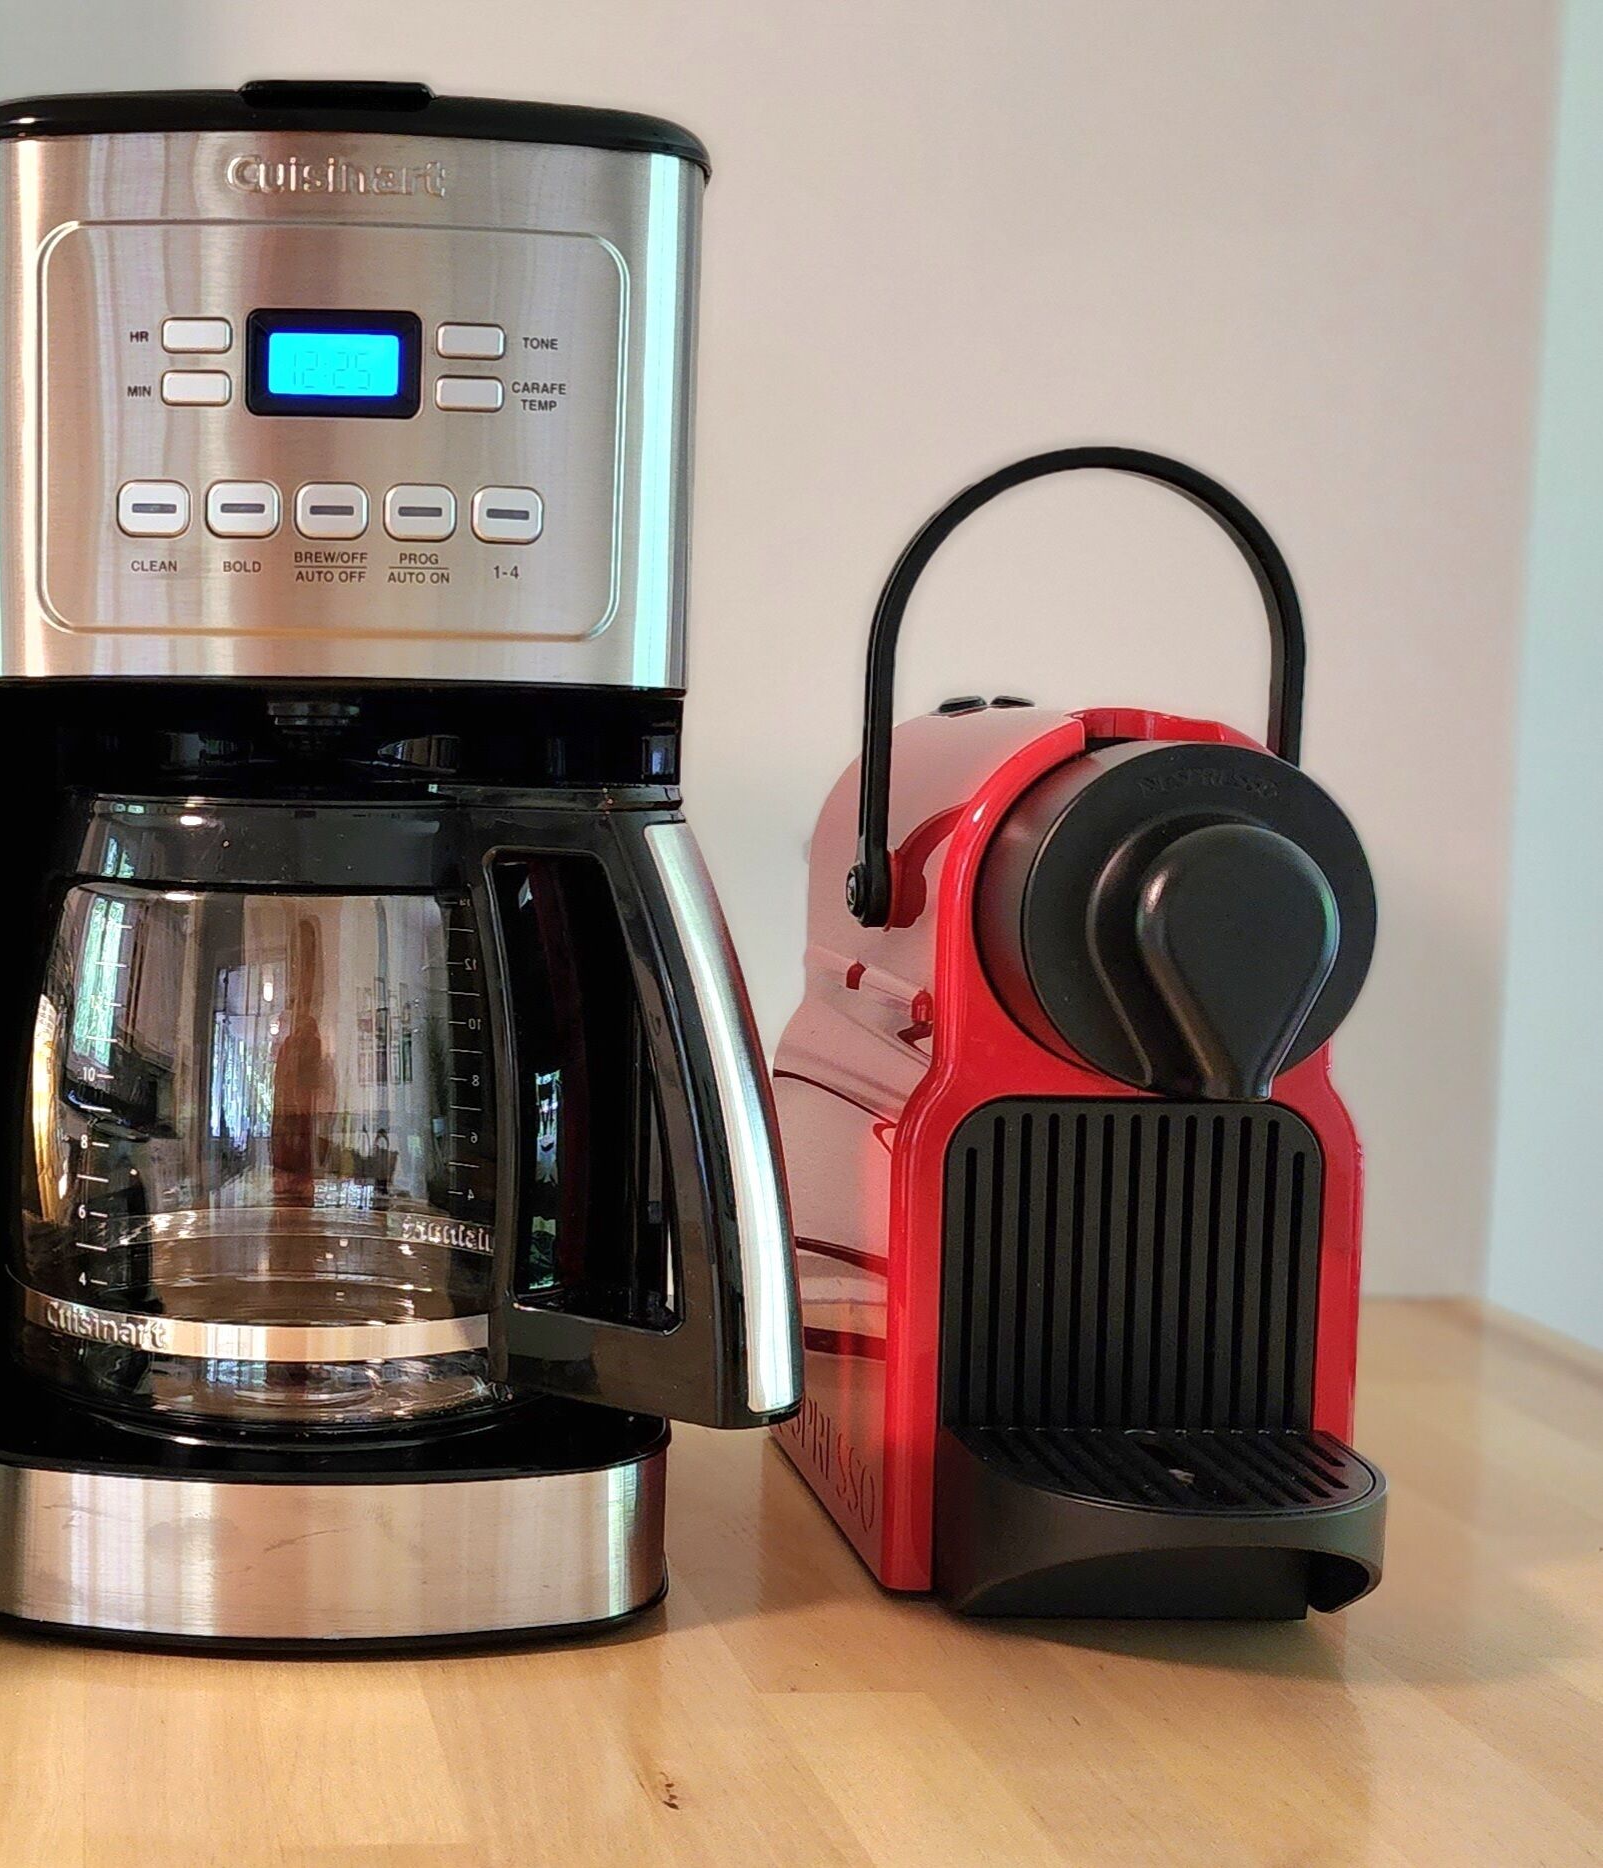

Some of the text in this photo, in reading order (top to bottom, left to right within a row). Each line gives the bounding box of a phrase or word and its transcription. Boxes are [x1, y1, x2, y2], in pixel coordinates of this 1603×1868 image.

[226, 154, 447, 197] Cuisinart
[129, 331, 150, 344] HR
[522, 336, 559, 351] TONE
[294, 351, 372, 390] 12:25
[127, 385, 153, 398] MIN
[511, 381, 567, 395] CARAFE
[520, 399, 558, 412] TEMP
[294, 551, 368, 564] BREW/OFF
[399, 553, 439, 565] PROG
[130, 560, 178, 573] CLEAN
[222, 560, 262, 573] BOLD
[493, 565, 520, 580] 1-4
[295, 570, 367, 583] AUTO OFF
[387, 571, 450, 584] AUTO ON
[82, 1066, 97, 1082] 10
[79, 1133, 89, 1150] 8
[77, 1203, 87, 1220] 6
[77, 1271, 88, 1286] 4
[47, 1301, 169, 1350] Cuisinart
